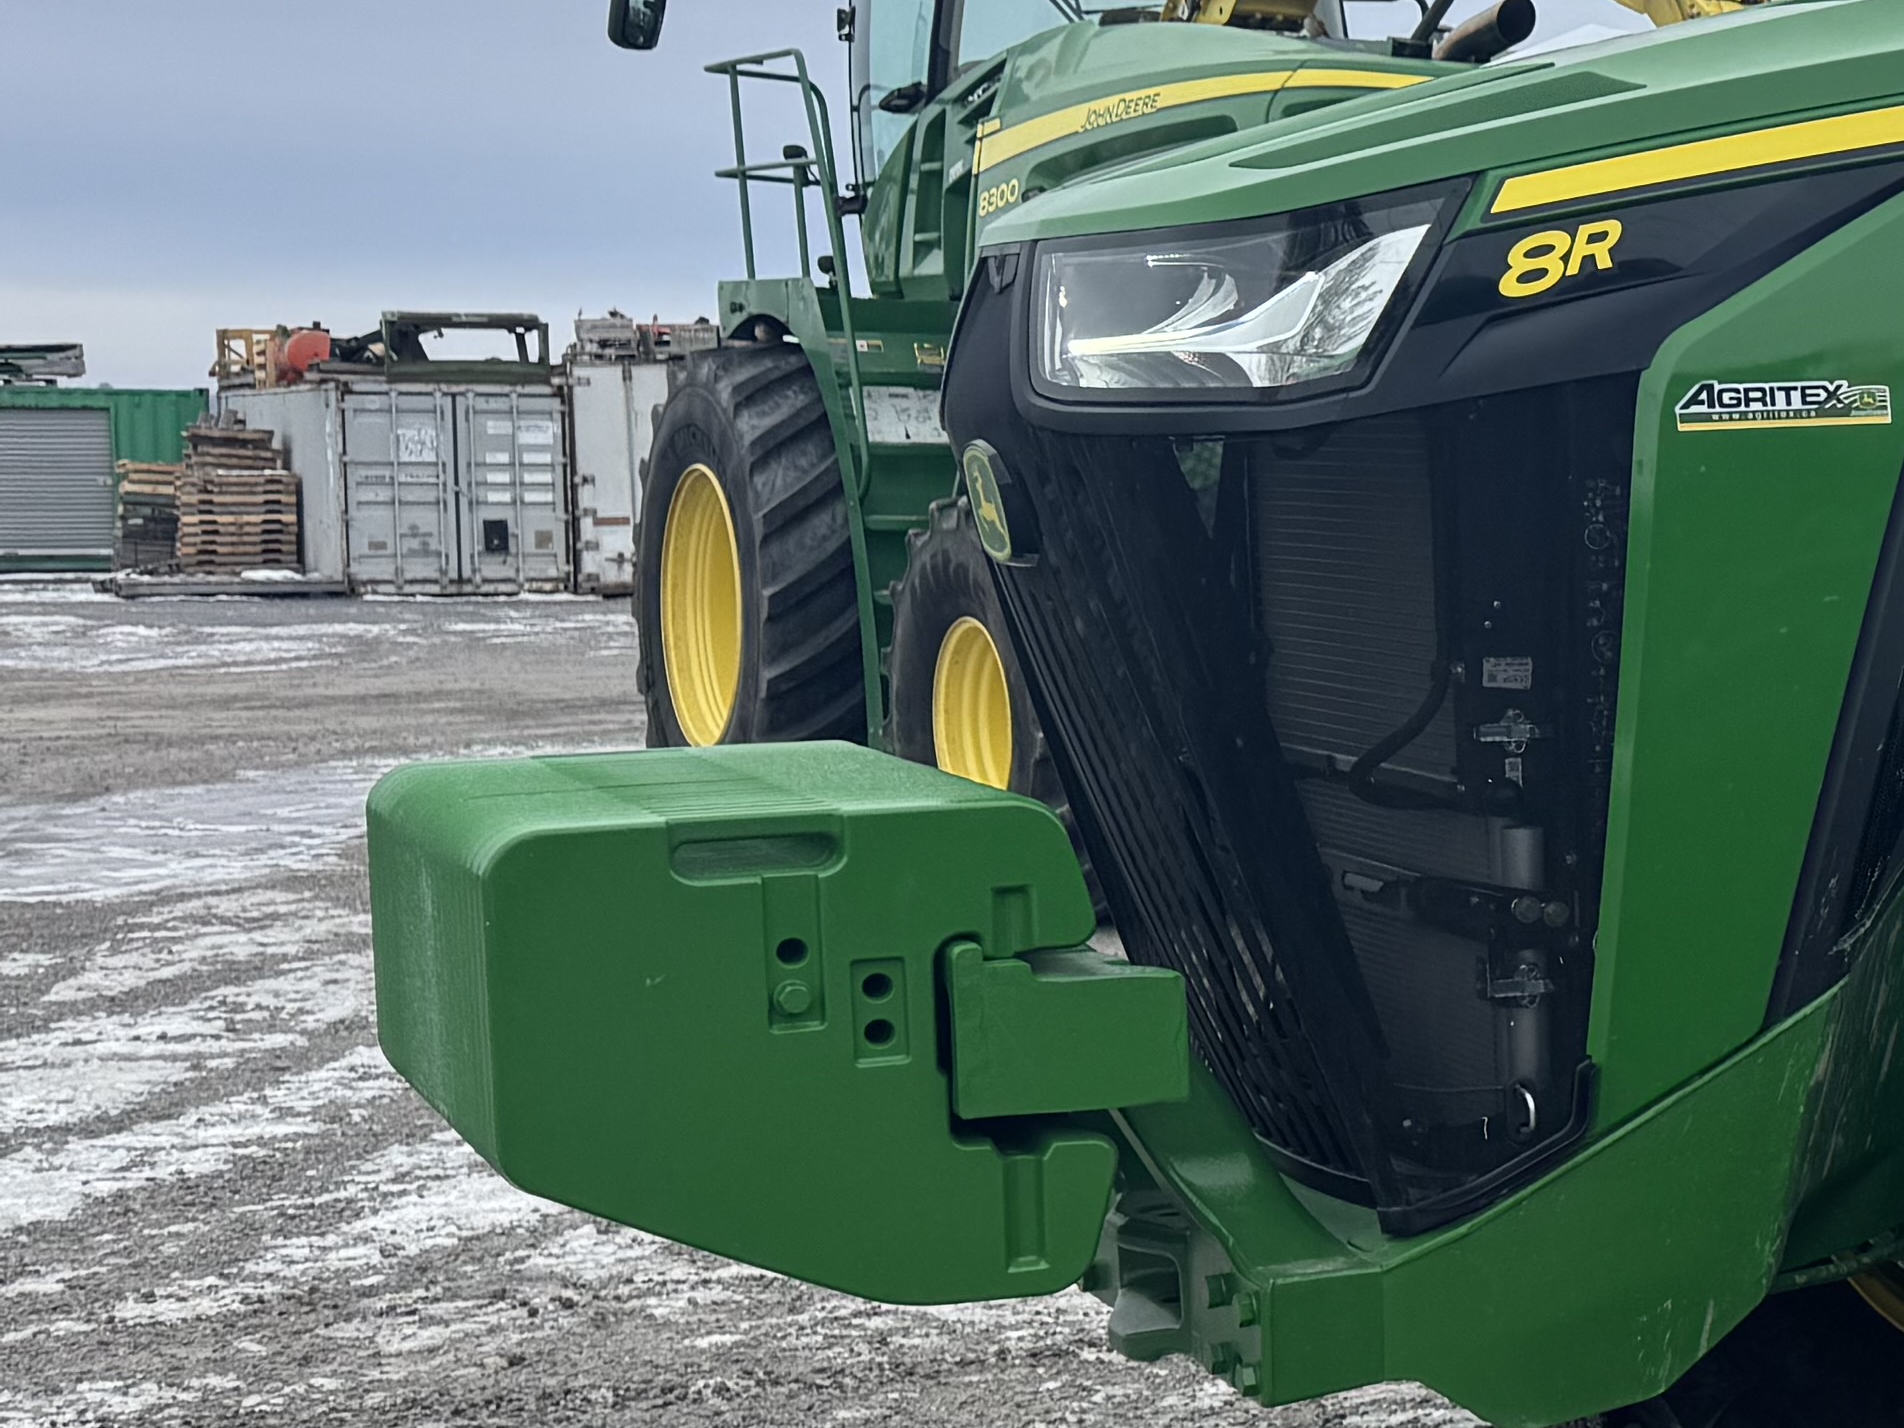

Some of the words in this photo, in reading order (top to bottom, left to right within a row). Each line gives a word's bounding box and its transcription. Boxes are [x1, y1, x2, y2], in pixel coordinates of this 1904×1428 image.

[1081, 107, 1112, 129] JOHN
[1114, 93, 1161, 119] DEERE
[978, 178, 1019, 218] 8300
[1498, 219, 1623, 298] 8R
[1680, 383, 1846, 409] AGRITEX
